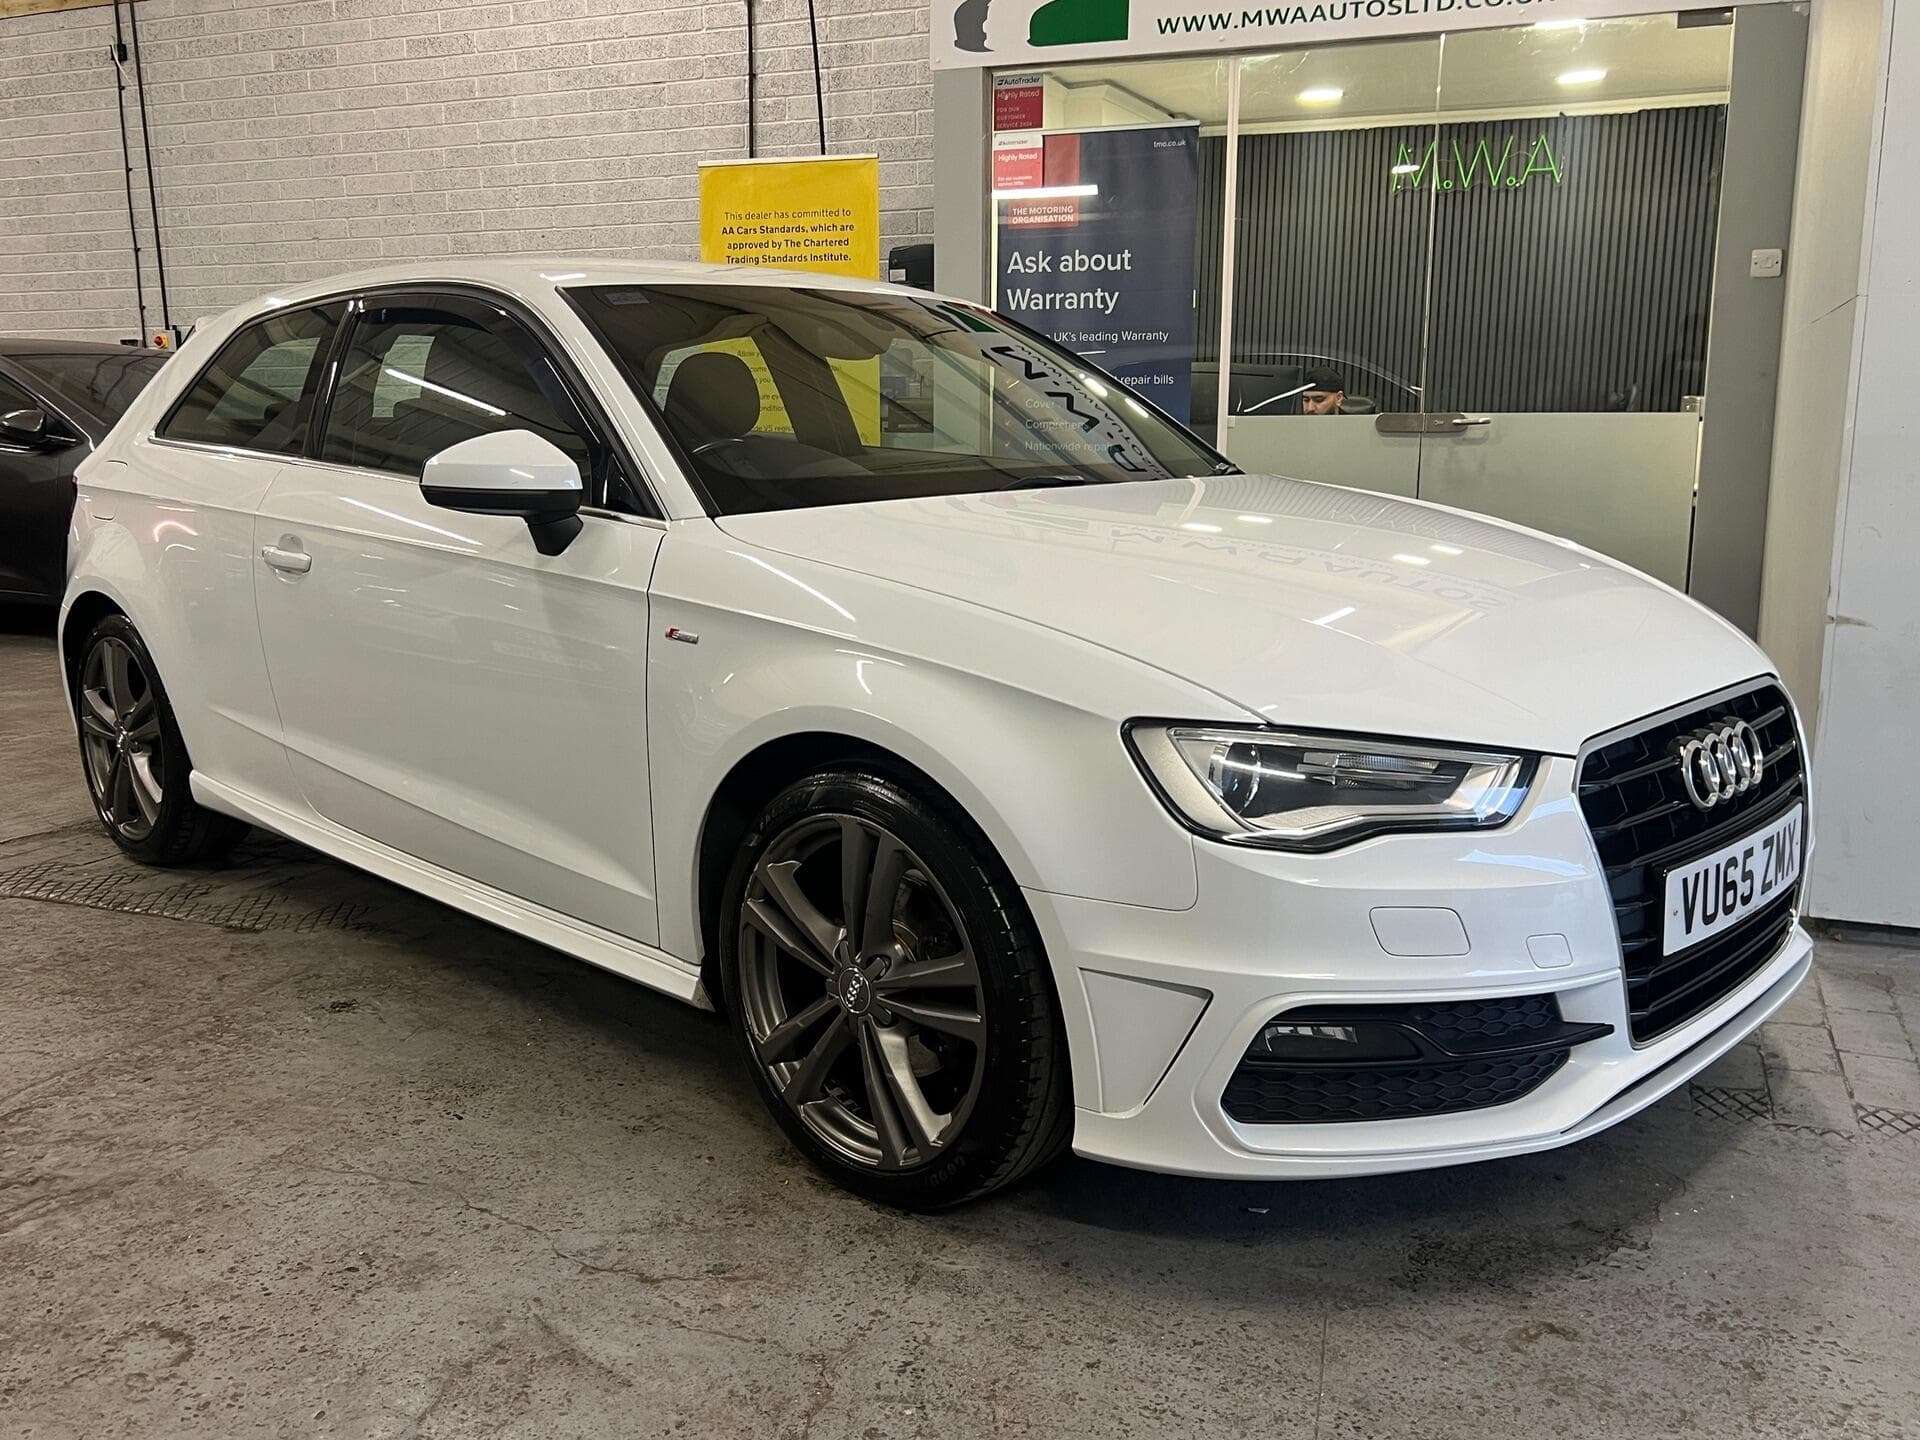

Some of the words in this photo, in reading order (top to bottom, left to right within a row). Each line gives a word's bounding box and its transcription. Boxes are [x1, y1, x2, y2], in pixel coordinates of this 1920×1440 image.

[1156, 0, 1551, 34] WWW.MWAAUTOSLTD..
[998, 154, 1017, 162] Highly
[725, 212, 742, 220] This
[745, 211, 772, 220] dealer
[774, 210, 789, 219] has
[792, 209, 838, 218] committed
[842, 208, 851, 216] to
[1012, 208, 1027, 216] THE
[1029, 206, 1073, 214] MOTORING
[1012, 214, 1074, 224] ORGANISATION
[722, 227, 735, 235] AA
[737, 226, 757, 235] Cars
[759, 225, 809, 235] Standards,
[810, 224, 838, 233] which
[840, 224, 854, 232] are
[727, 240, 769, 250] approved
[772, 239, 782, 250] by
[784, 239, 801, 248] The
[804, 238, 849, 247] Chartered
[726, 256, 760, 265] Trading
[762, 254, 808, 263] Standards
[810, 253, 852, 262] Institute.
[1007, 250, 1052, 274] Ask
[1059, 249, 1132, 272] about
[1007, 288, 1120, 314] Warranty
[1054, 332, 1076, 342] UK's
[1079, 331, 1118, 343] leading
[1121, 331, 1169, 342] Warranty
[1121, 375, 1151, 386] repair
[1153, 375, 1174, 384] bills
[1682, 847, 1754, 935] VU65
[1761, 818, 1797, 896] ZMX
